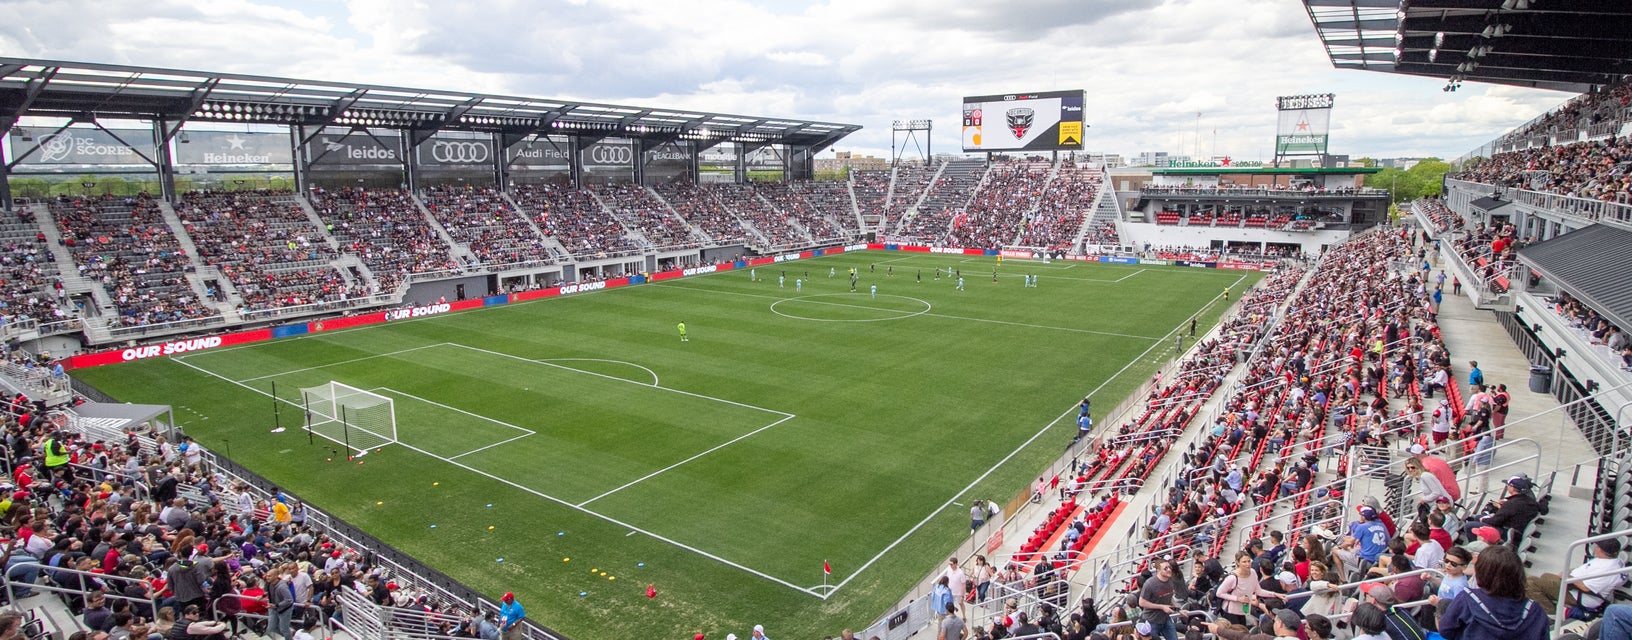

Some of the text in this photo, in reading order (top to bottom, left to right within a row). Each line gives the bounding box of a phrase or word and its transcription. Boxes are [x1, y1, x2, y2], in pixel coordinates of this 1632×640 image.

[1281, 136, 1323, 144] Heineken
[77, 145, 133, 155] SCORES
[347, 145, 396, 159] leidos
[516, 149, 569, 158] Audi Field
[204, 152, 270, 163] Heineken
[1169, 160, 1217, 168] Heineken
[683, 265, 717, 276] OUR SOUND
[560, 281, 606, 294] OUR SOUND
[412, 303, 451, 317] SOUND
[122, 336, 222, 361] OUR SOUND
[1372, 532, 1386, 546] 42
